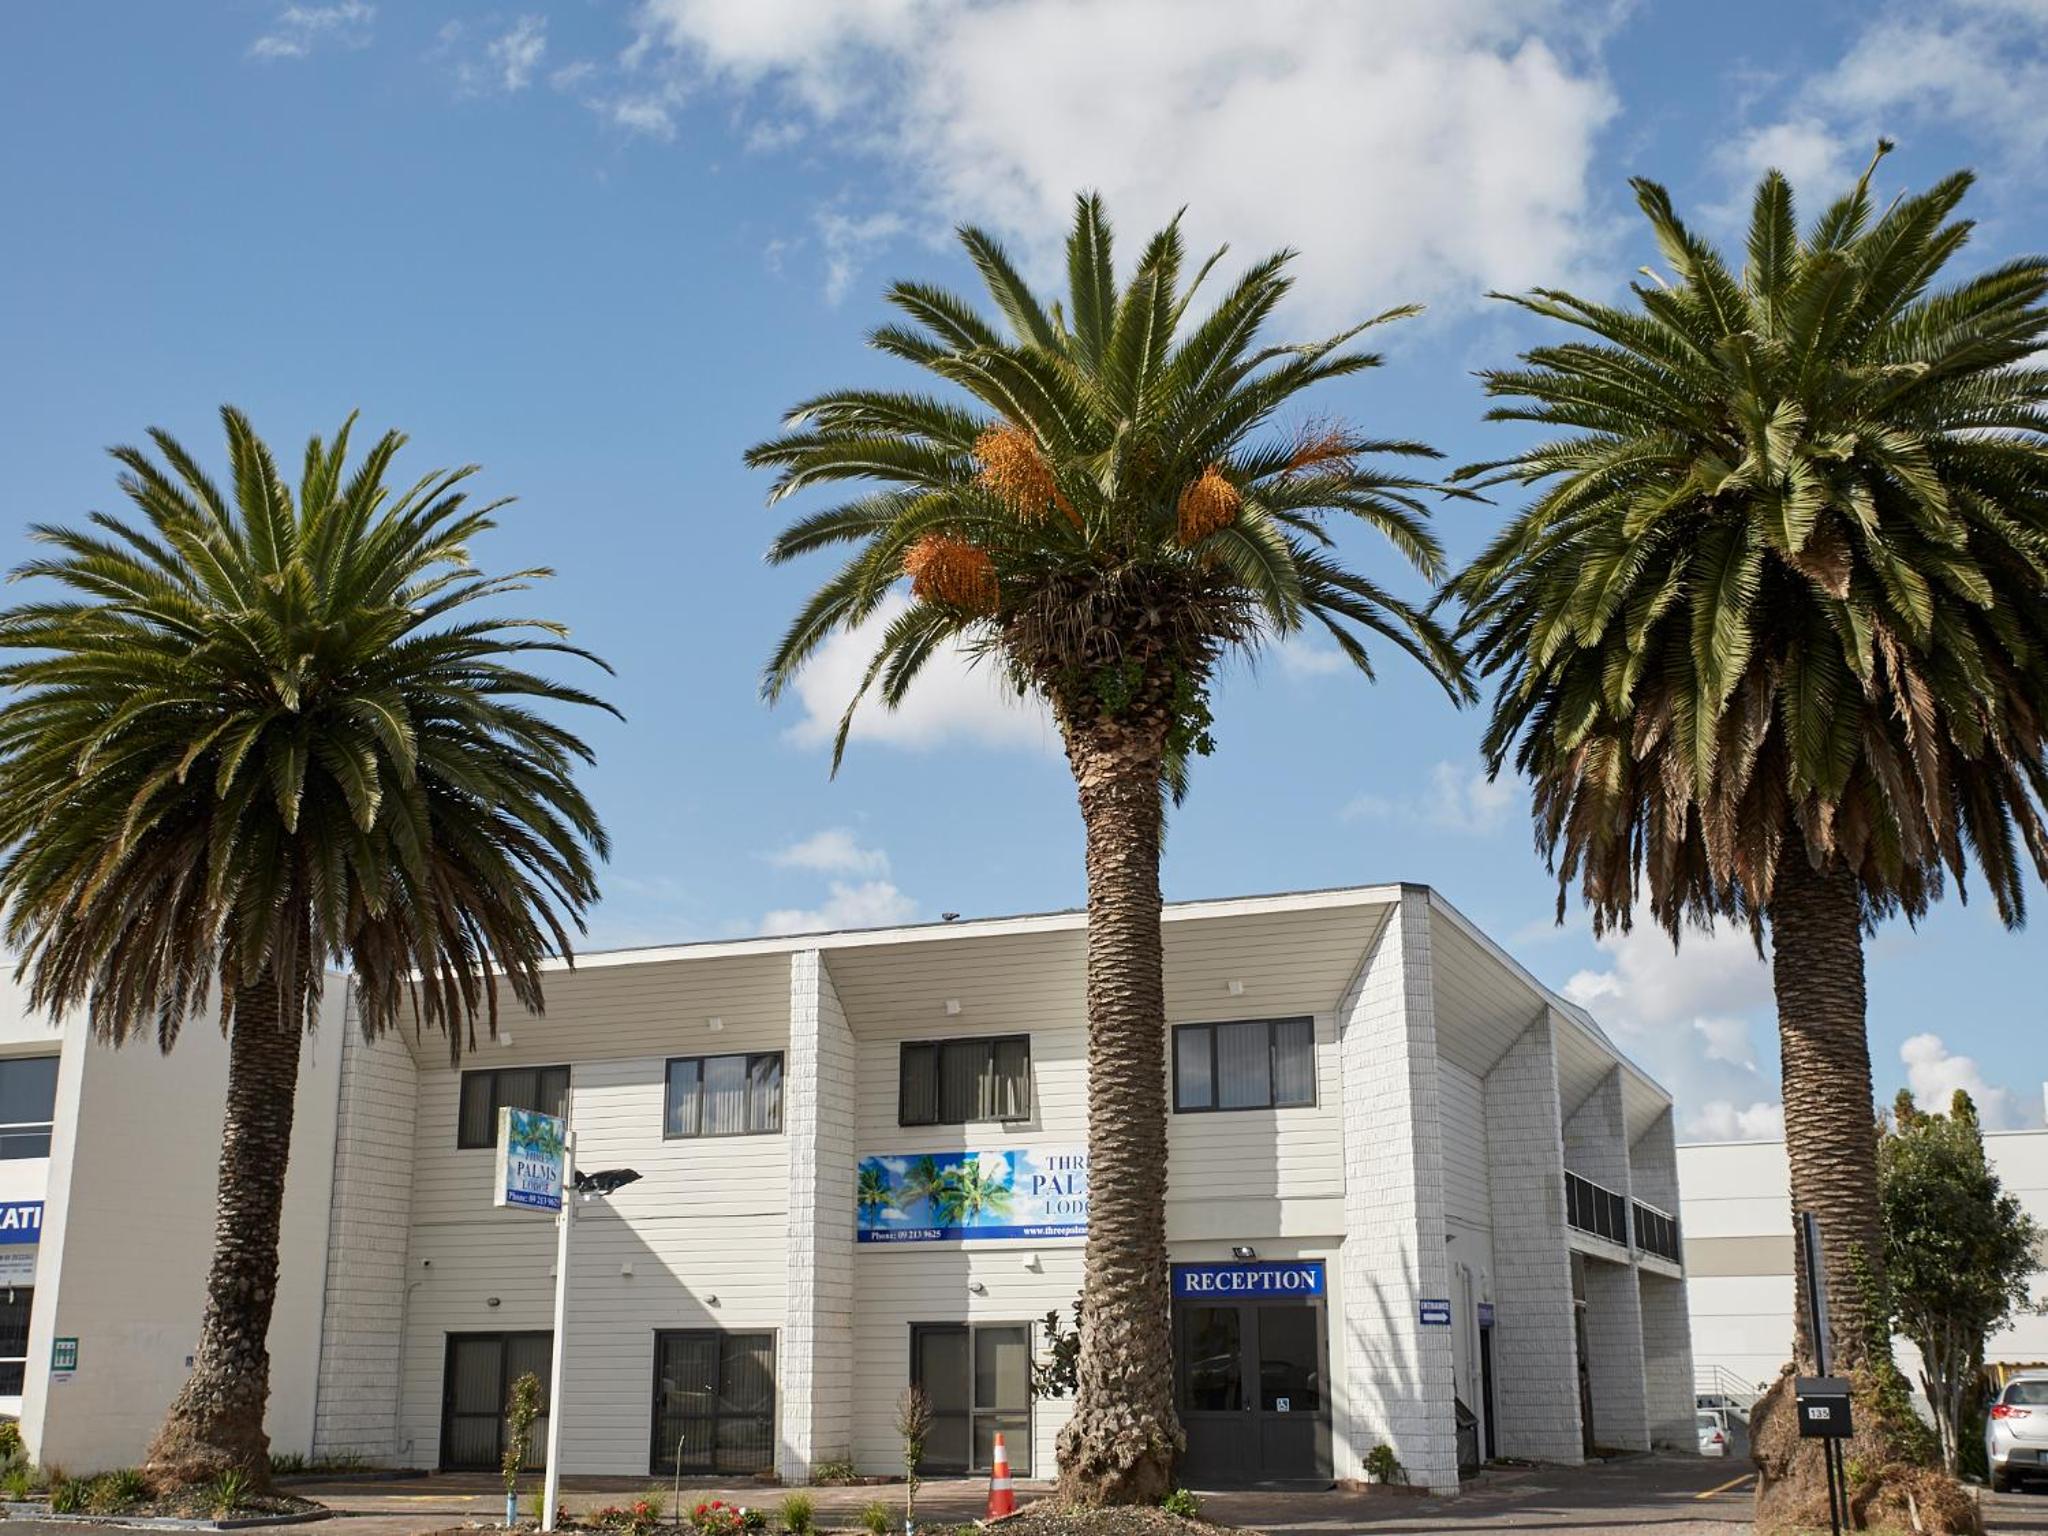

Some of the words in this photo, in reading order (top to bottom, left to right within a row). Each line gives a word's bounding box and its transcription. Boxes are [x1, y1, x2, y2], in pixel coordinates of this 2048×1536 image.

[1045, 1155, 1087, 1171] THR
[517, 1161, 556, 1182] PALMS
[522, 1180, 548, 1193] LODGE
[1033, 1174, 1088, 1196] PAL
[1046, 1200, 1088, 1215] LOD
[0, 1206, 41, 1229] ATI
[871, 1231, 897, 1240] Phone:
[908, 1230, 921, 1239] 213
[1185, 1270, 1317, 1291] RECEPTION
[1810, 1408, 1829, 1418] 135
